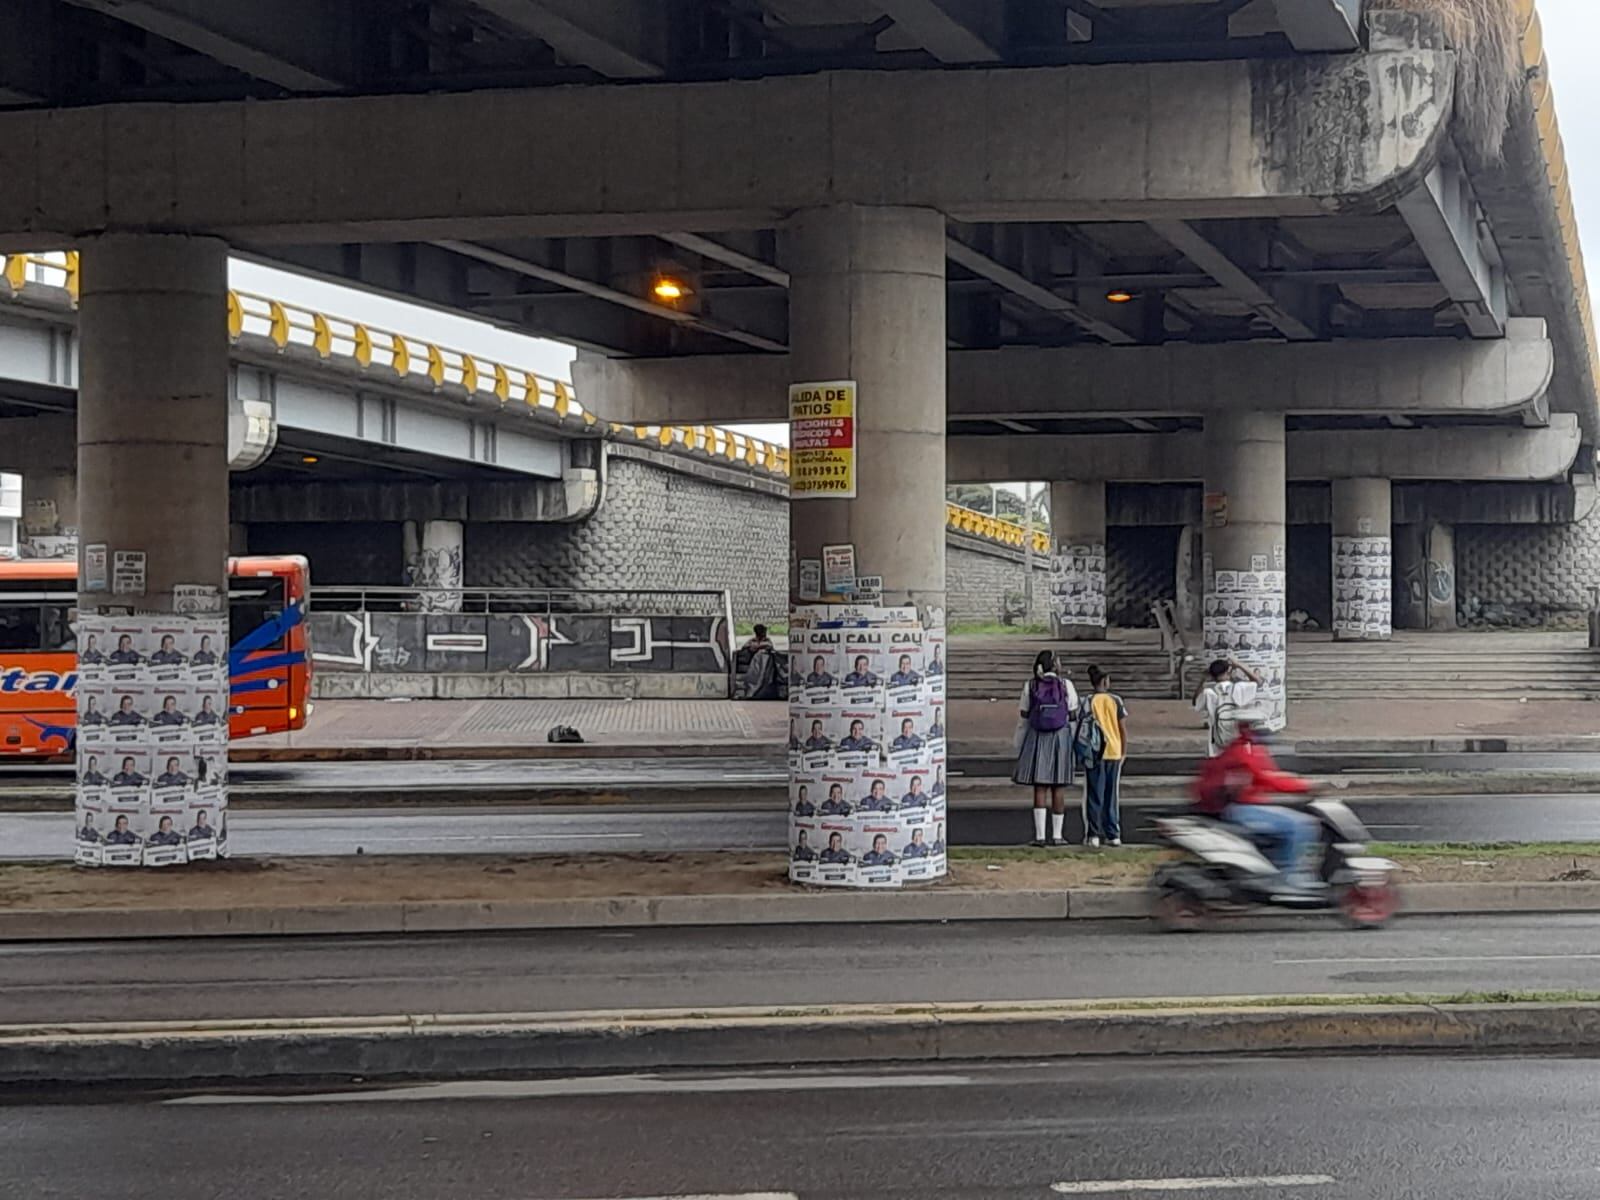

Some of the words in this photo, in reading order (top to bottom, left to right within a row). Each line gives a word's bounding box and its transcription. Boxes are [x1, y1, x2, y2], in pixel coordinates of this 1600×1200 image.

[825, 389, 846, 402] DE
[810, 633, 841, 644] CALI
[846, 633, 881, 644] CALI
